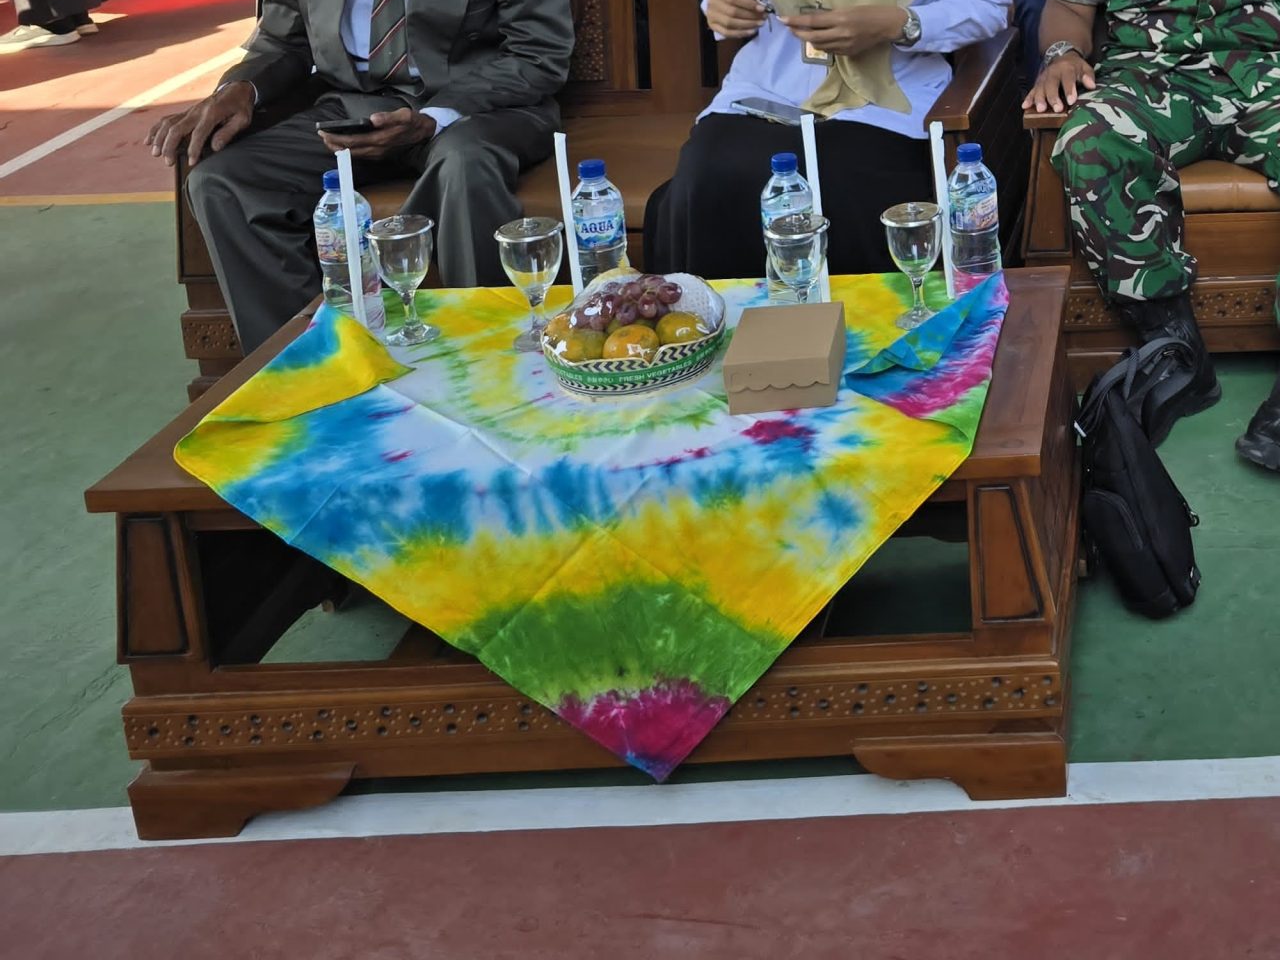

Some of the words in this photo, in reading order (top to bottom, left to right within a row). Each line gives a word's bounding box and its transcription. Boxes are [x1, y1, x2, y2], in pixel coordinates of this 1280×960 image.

[581, 220, 615, 234] AQUA
[619, 373, 645, 383] FRESH
[646, 360, 692, 378] VEGETABLES
